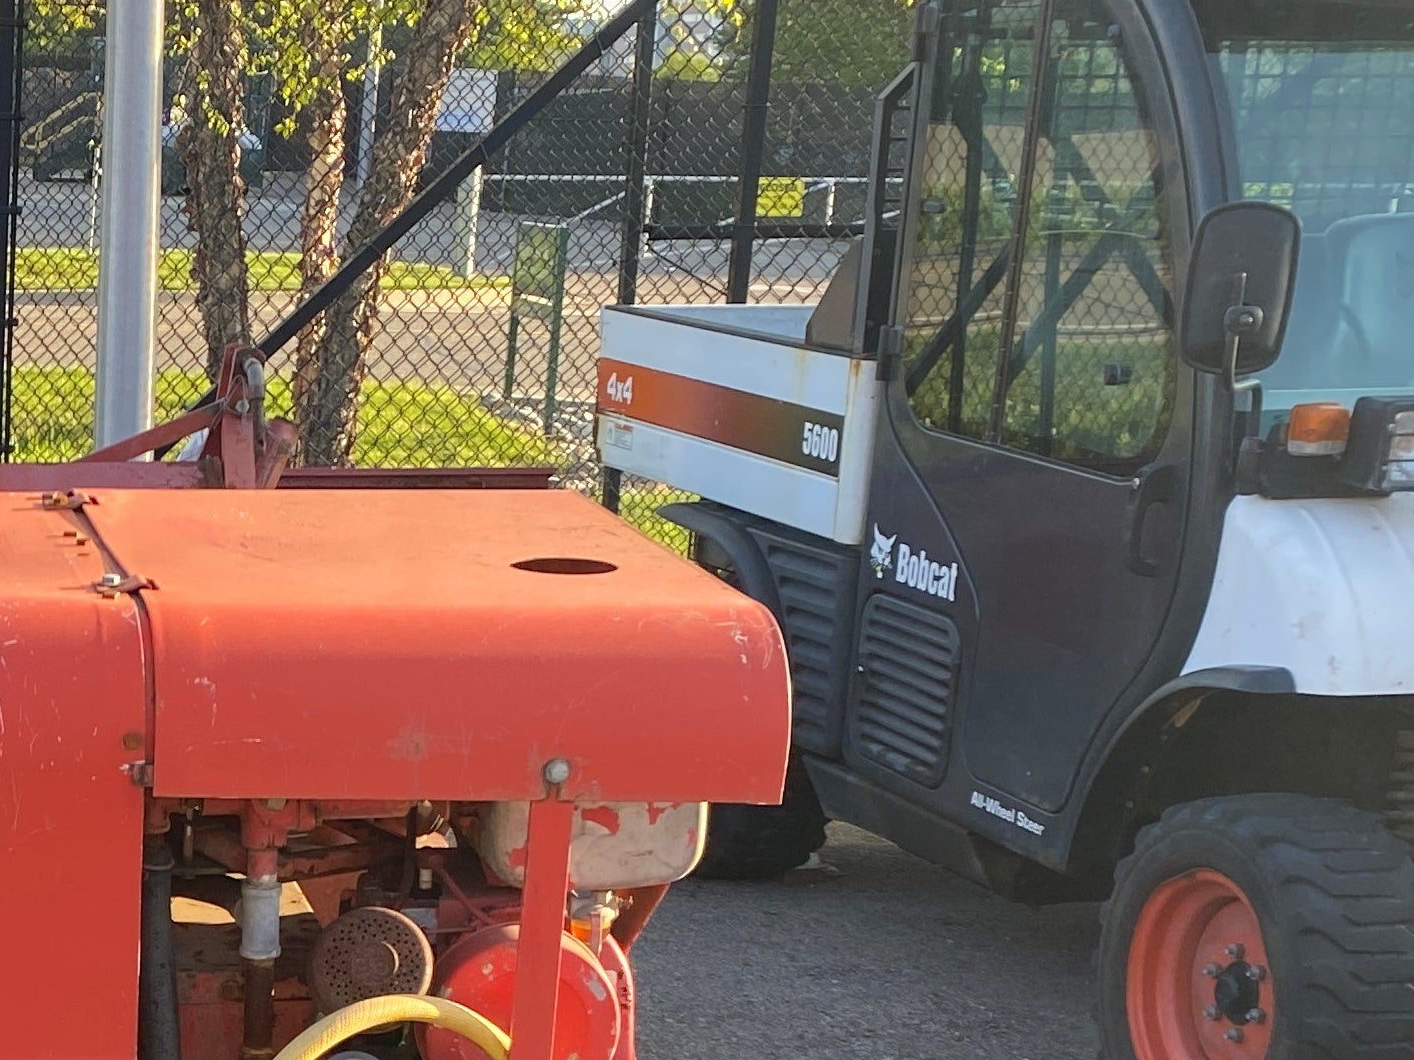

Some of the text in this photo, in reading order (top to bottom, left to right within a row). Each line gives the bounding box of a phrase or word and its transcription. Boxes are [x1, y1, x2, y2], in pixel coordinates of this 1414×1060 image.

[607, 372, 633, 404] 4x4
[802, 421, 838, 462] 5600
[895, 543, 958, 601] Bobcat
[970, 791, 1045, 836] All-Wheel Steer
